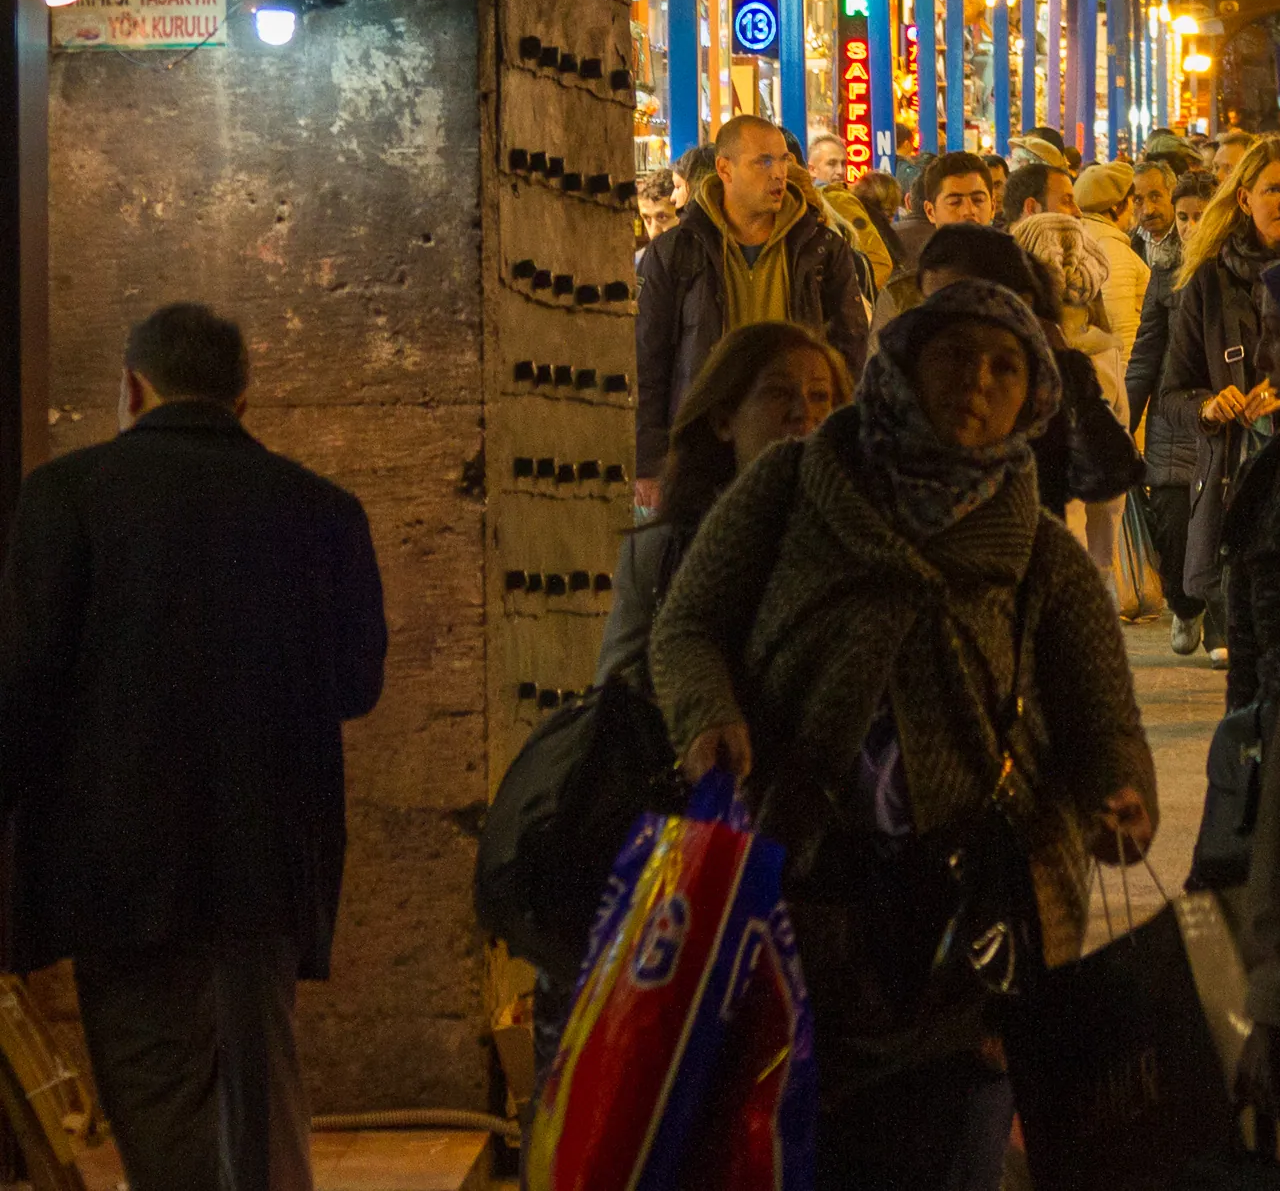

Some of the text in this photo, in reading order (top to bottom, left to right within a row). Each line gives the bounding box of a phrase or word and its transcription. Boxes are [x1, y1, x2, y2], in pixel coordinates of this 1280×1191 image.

[152, 15, 217, 38] KURULU
[741, 11, 769, 40] 13
[843, 41, 870, 185] SAFFRON
